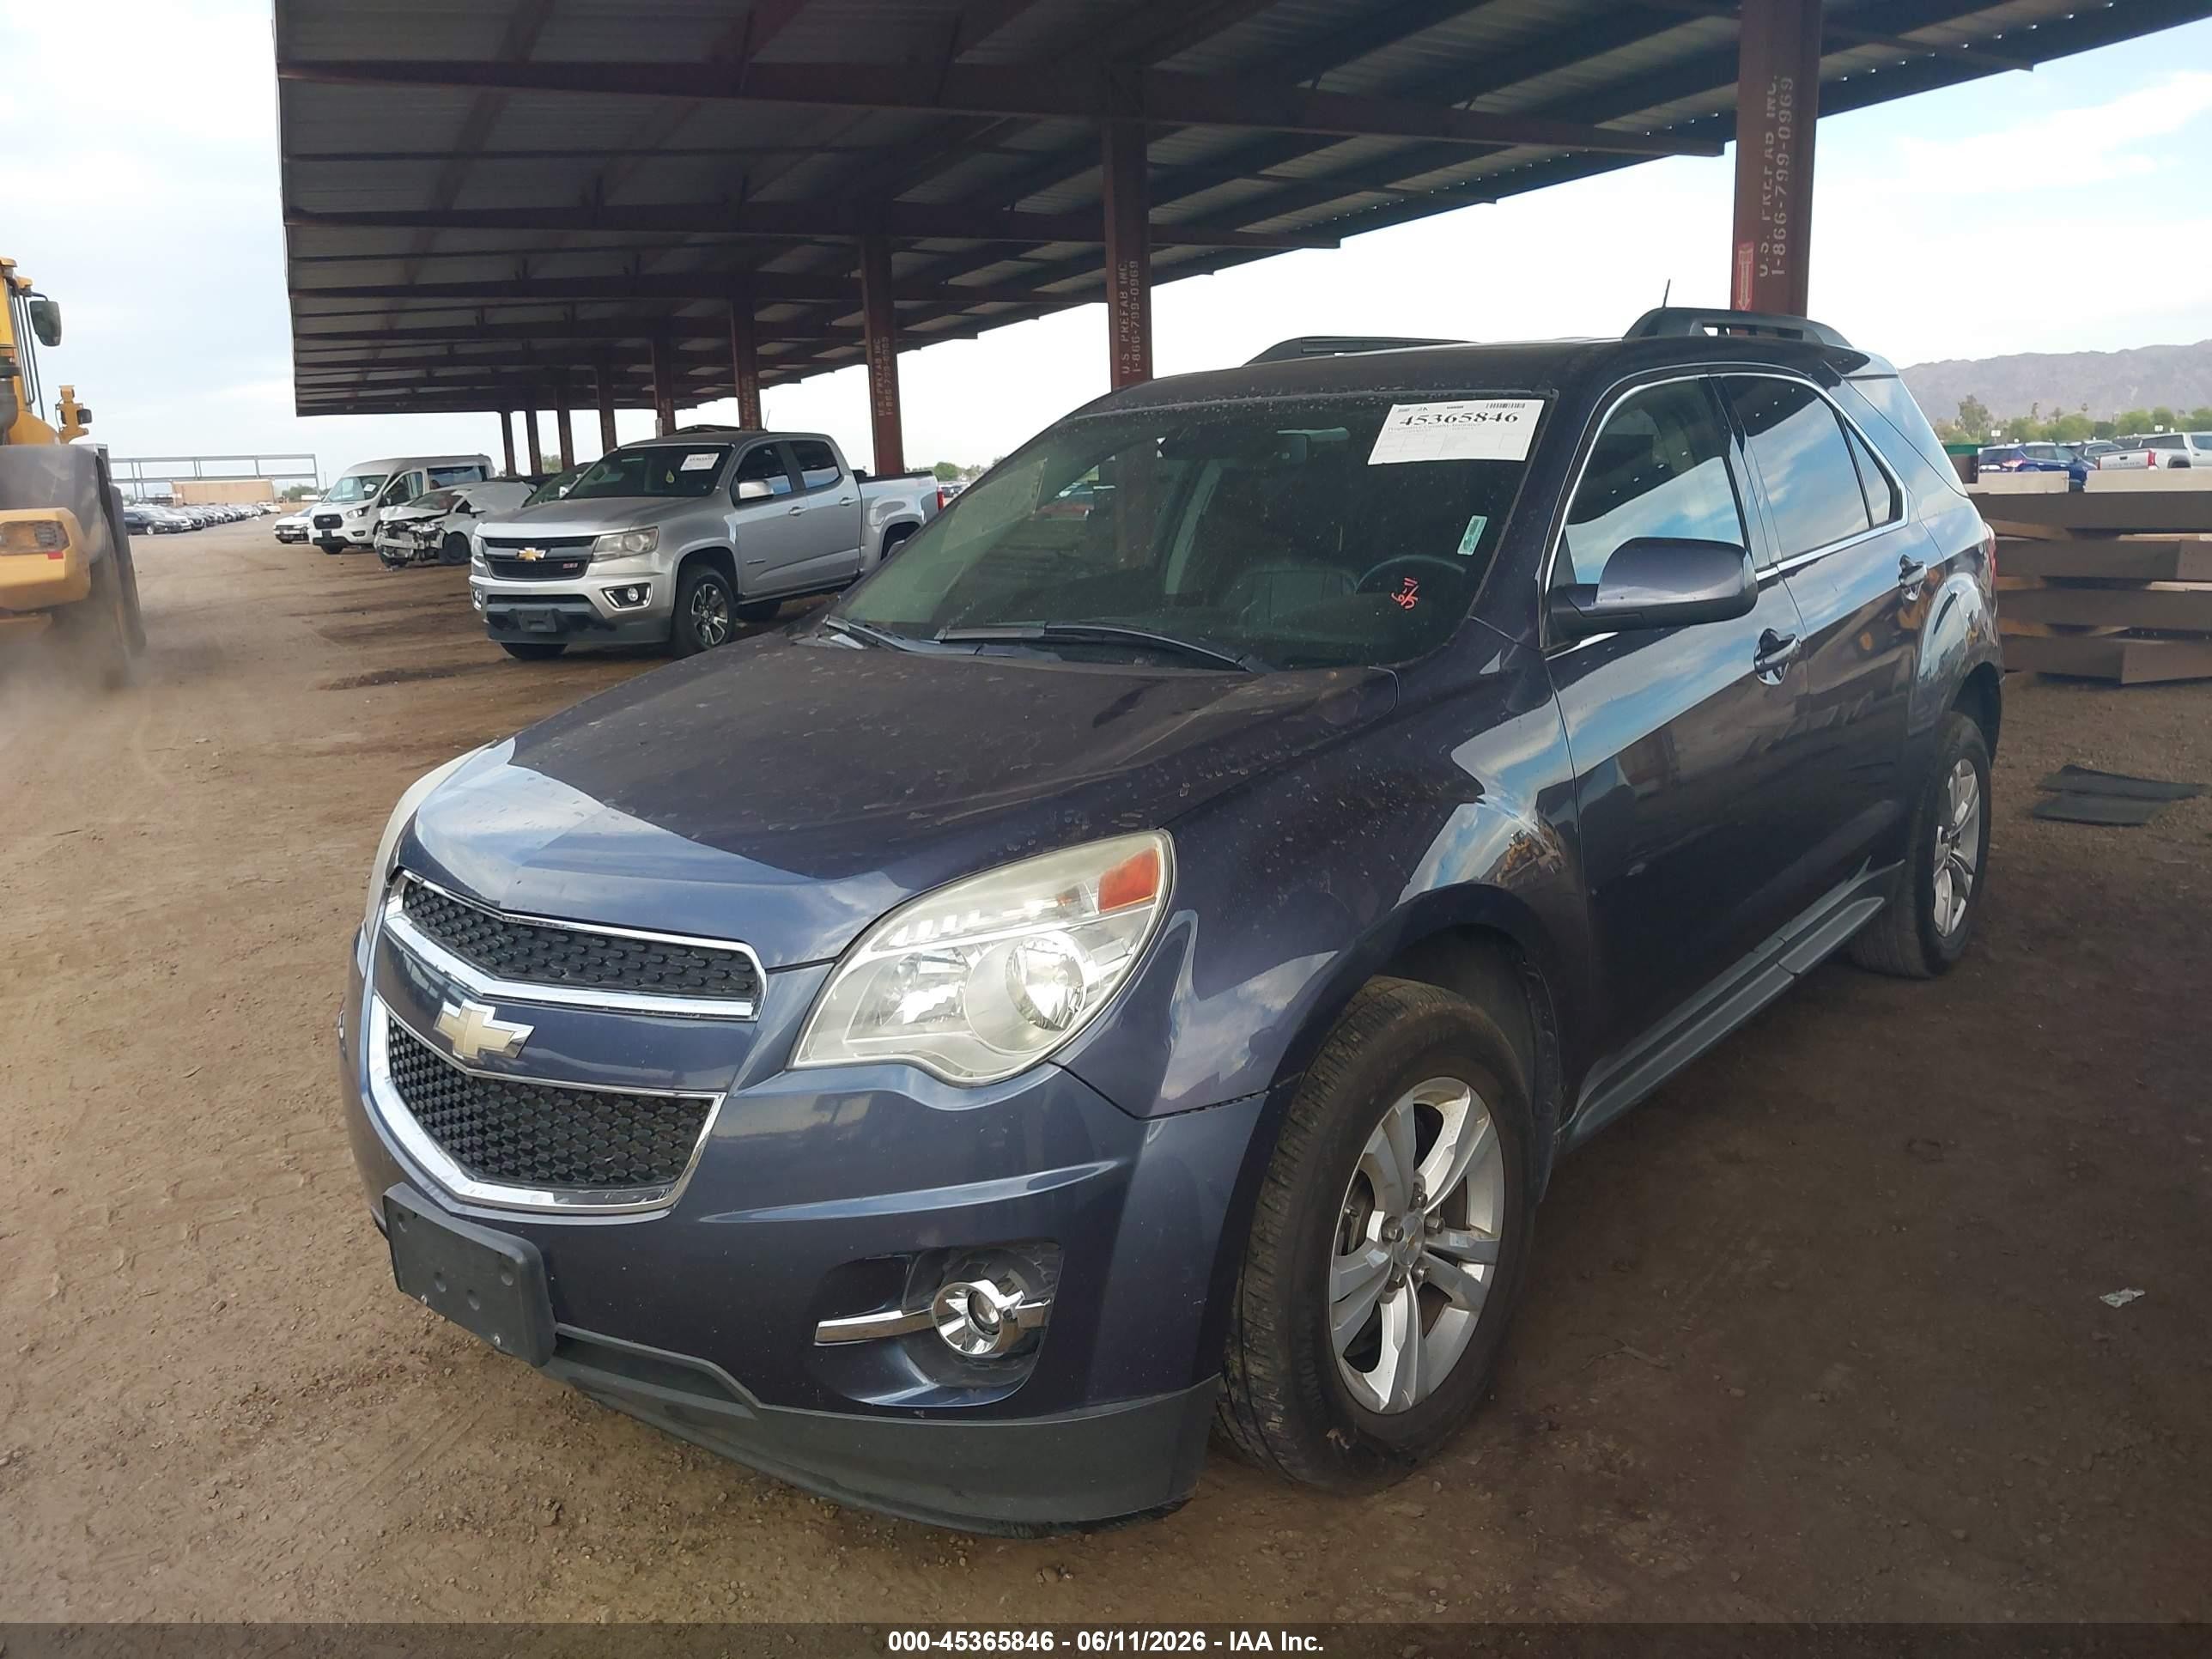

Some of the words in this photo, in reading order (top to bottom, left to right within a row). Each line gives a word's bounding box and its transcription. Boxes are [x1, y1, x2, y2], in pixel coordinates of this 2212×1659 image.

[1771, 76, 1794, 276] 1-866-799-0969
[1119, 290, 1129, 343] PREFAB
[1400, 412, 1518, 426] 45365846
